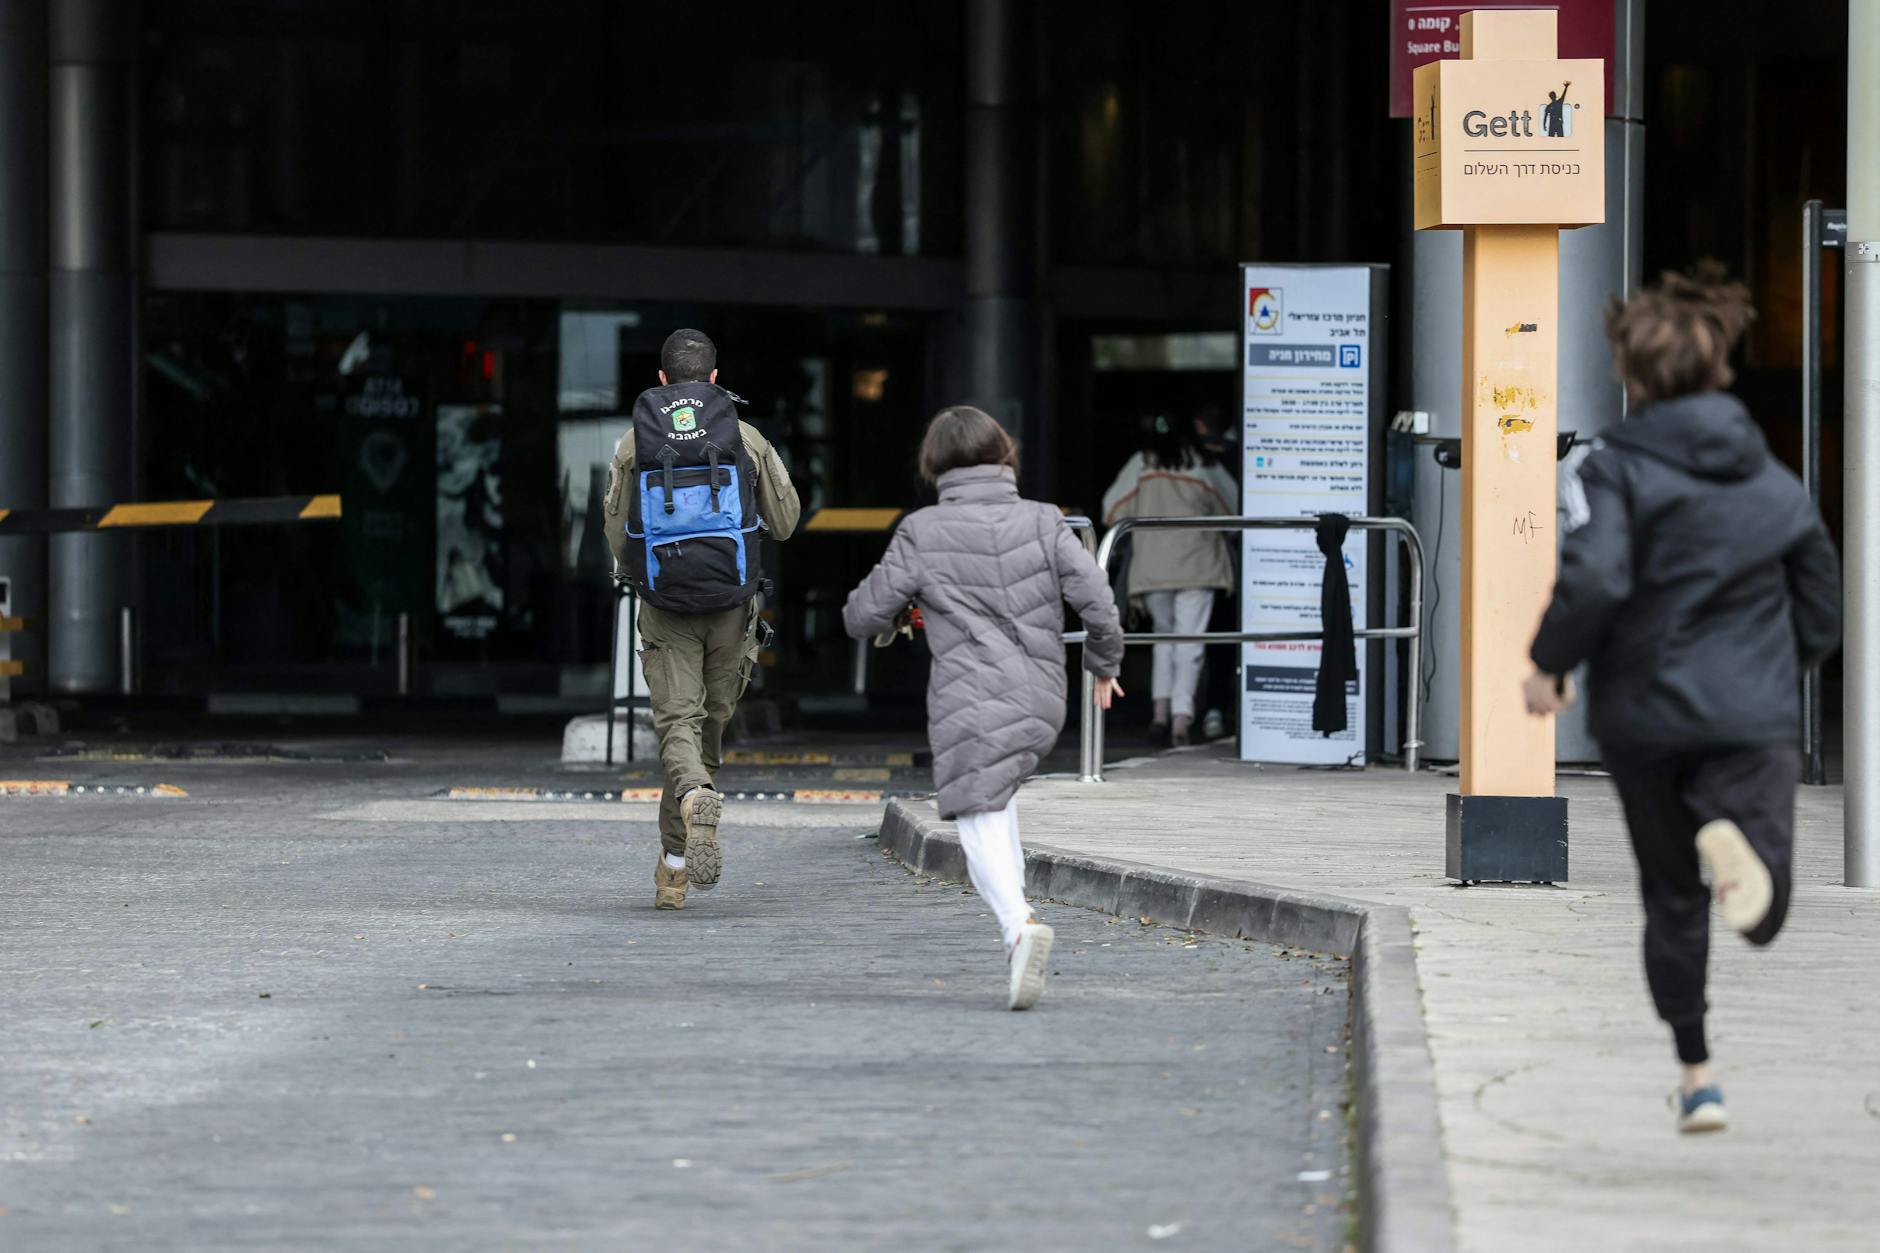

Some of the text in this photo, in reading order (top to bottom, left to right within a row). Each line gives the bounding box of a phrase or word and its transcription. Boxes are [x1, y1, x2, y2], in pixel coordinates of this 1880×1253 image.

[1418, 17, 1451, 32] קומה
[1407, 40, 1460, 55] Square Bu
[1463, 110, 1533, 138] Gett
[1463, 161, 1581, 178] כניסת דרך השלום
[1288, 311, 1320, 321] עזריאלי
[1322, 313, 1344, 322] מרכז
[1329, 328, 1366, 336] תל אביב
[1269, 349, 1331, 364] מחירון חניה
[660, 398, 704, 414] מרמת-גן
[667, 428, 707, 441] באהבה
